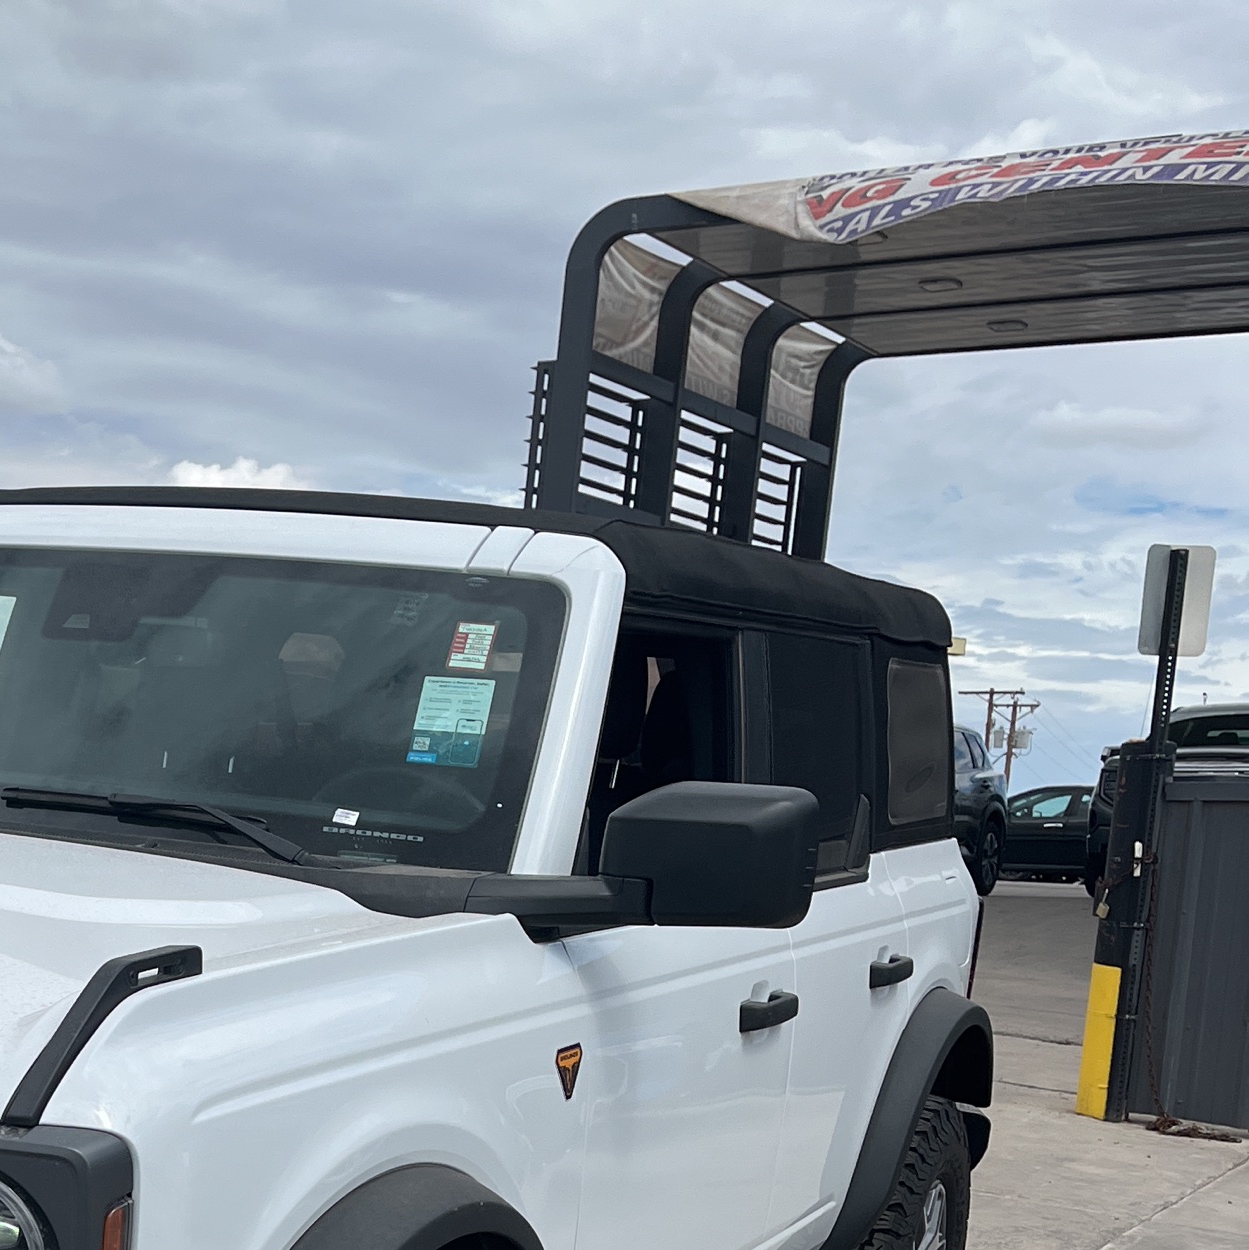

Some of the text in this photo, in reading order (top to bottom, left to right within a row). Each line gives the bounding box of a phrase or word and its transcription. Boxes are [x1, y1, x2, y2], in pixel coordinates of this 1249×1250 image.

[929, 139, 1249, 187] CENTE
[955, 166, 1164, 200] WITHIN
[322, 826, 424, 842] BRONCO
